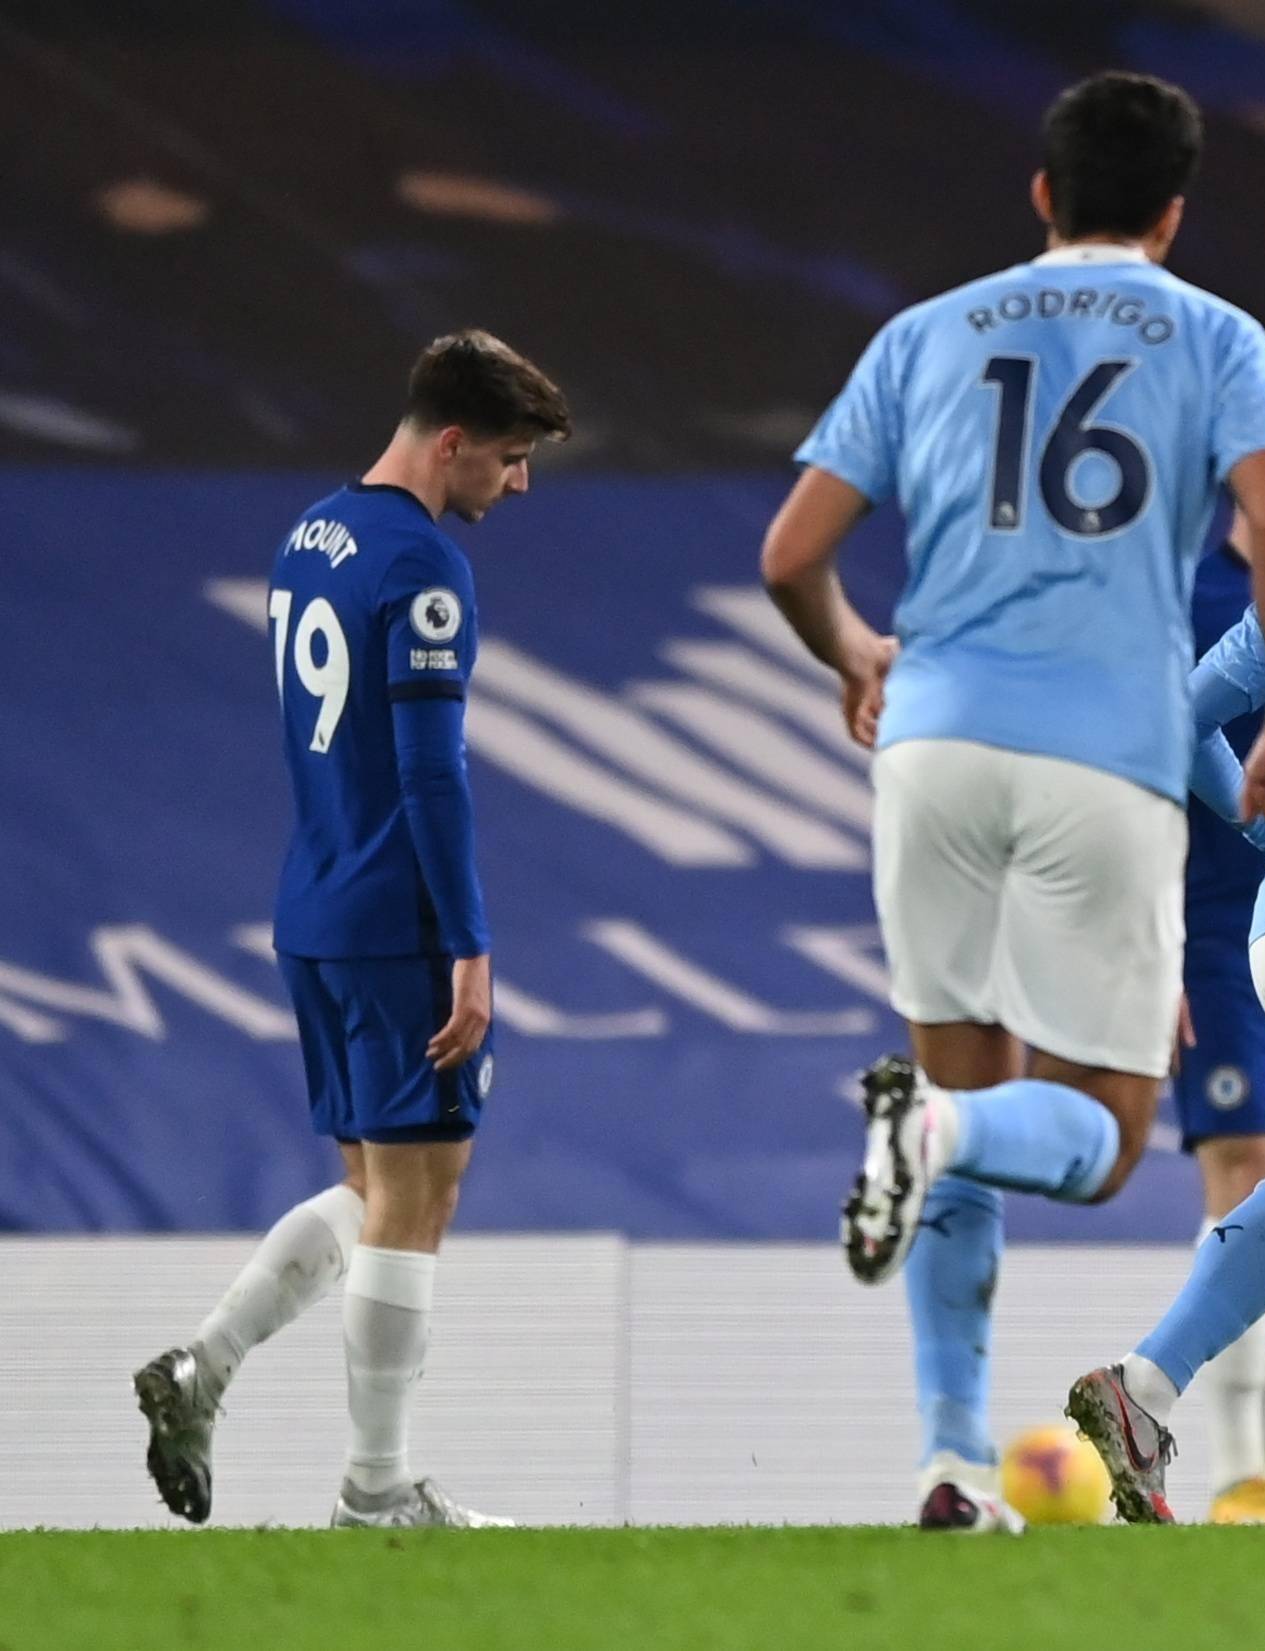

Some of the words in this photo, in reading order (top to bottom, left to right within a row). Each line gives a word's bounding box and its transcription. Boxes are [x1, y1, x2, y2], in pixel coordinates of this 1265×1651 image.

[966, 287, 1174, 346] RODRIGO
[978, 355, 1152, 537] 16
[283, 518, 358, 570] MOUNT
[268, 588, 350, 754] 19
